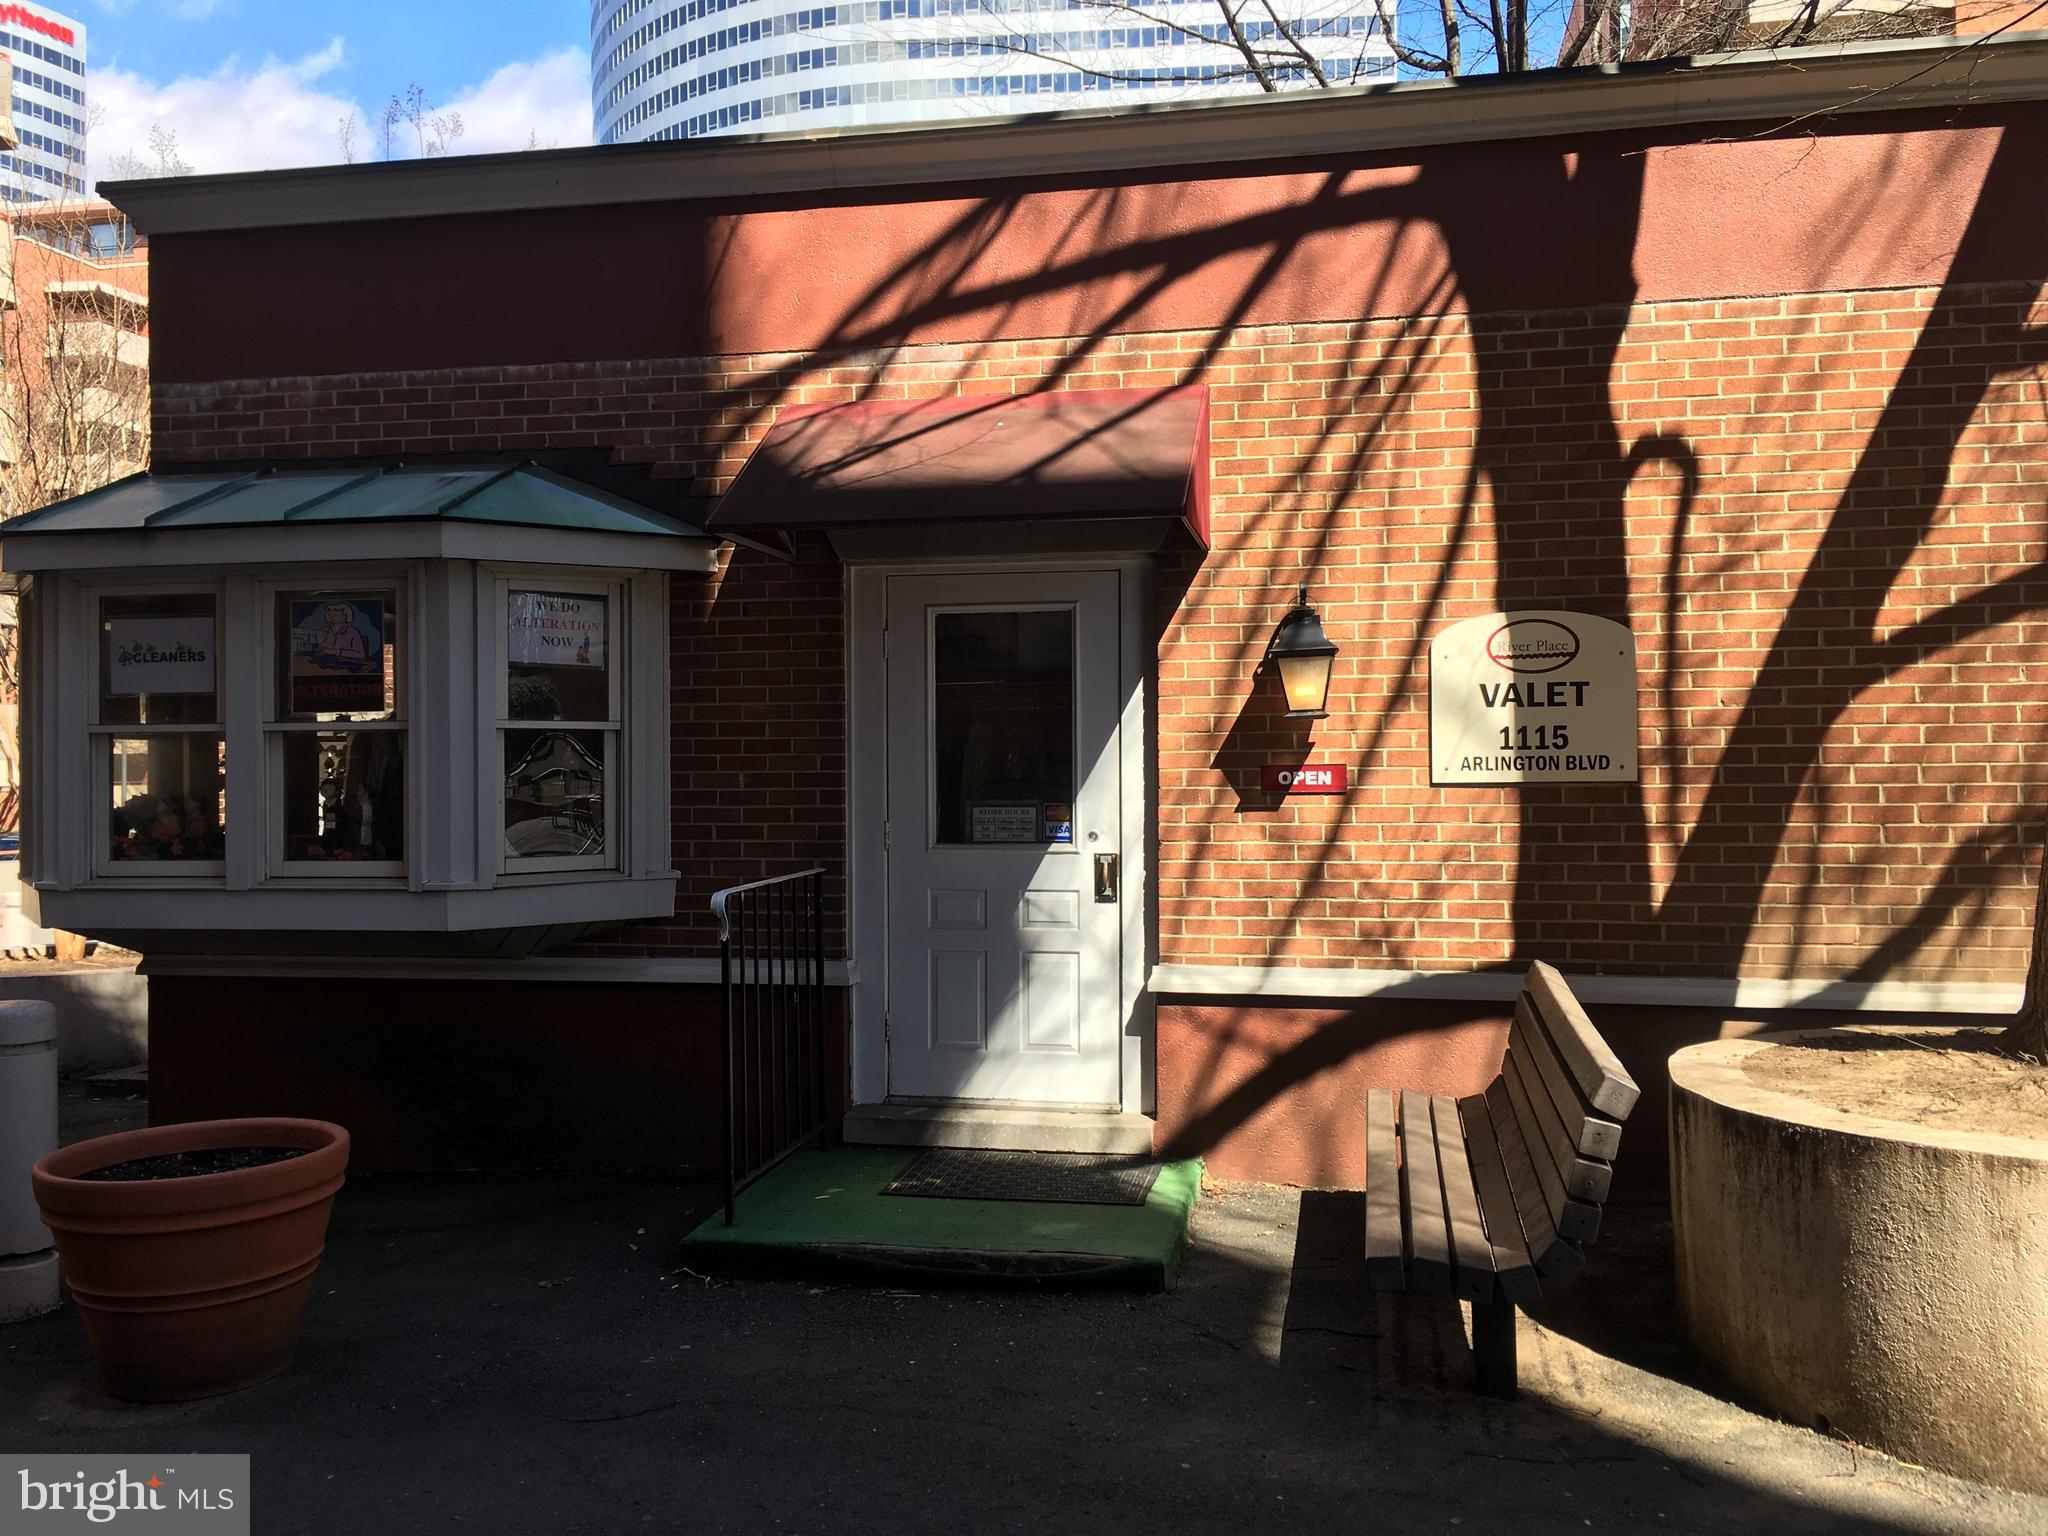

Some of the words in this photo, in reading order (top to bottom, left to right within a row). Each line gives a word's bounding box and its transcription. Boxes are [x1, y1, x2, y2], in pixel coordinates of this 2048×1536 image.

[536, 599, 558, 612] WE
[562, 601, 580, 614] DO
[513, 616, 600, 632] ALTERATION
[541, 635, 573, 648] NOW
[1497, 639, 1531, 652] River
[1536, 639, 1569, 652] Place
[133, 650, 206, 664] CLEANERS
[294, 683, 382, 697] ALTERATION
[1479, 681, 1590, 708] VALET
[1499, 725, 1569, 751] 1115
[1460, 755, 1560, 772] ARLINGTON
[1565, 754, 1611, 771] BLVD
[1277, 770, 1333, 785] OPEN
[979, 808, 1003, 816] STORE
[1004, 808, 1030, 816] HOURS
[1047, 824, 1071, 834] VISA
